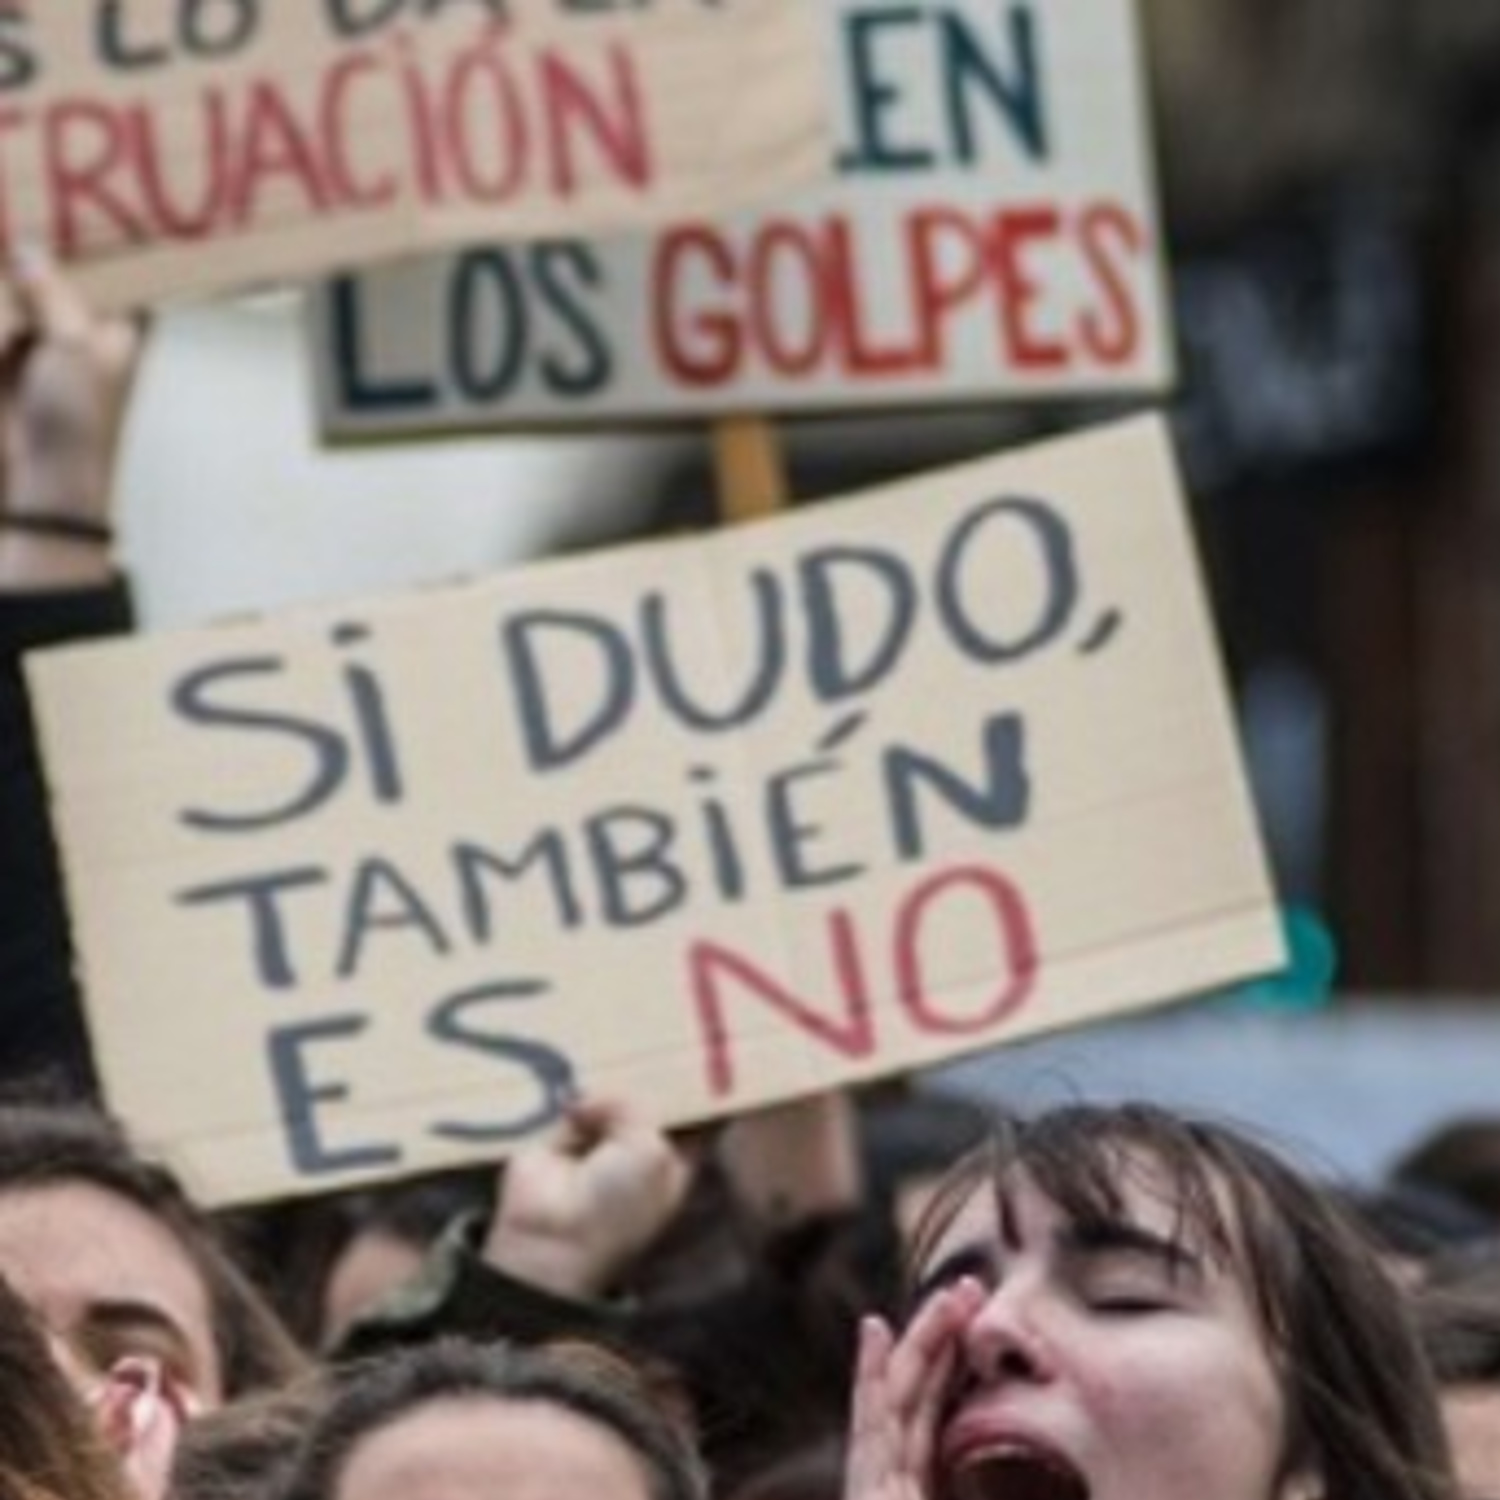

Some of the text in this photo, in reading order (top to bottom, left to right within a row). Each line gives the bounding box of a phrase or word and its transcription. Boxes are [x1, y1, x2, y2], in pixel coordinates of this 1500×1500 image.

[0, 28, 655, 265] RUACIÓN
[835, 4, 1047, 172] EN
[328, 203, 1144, 410] LOS GOLPES
[502, 494, 1124, 772] DUDO,
[266, 863, 1040, 1176] ES NO
